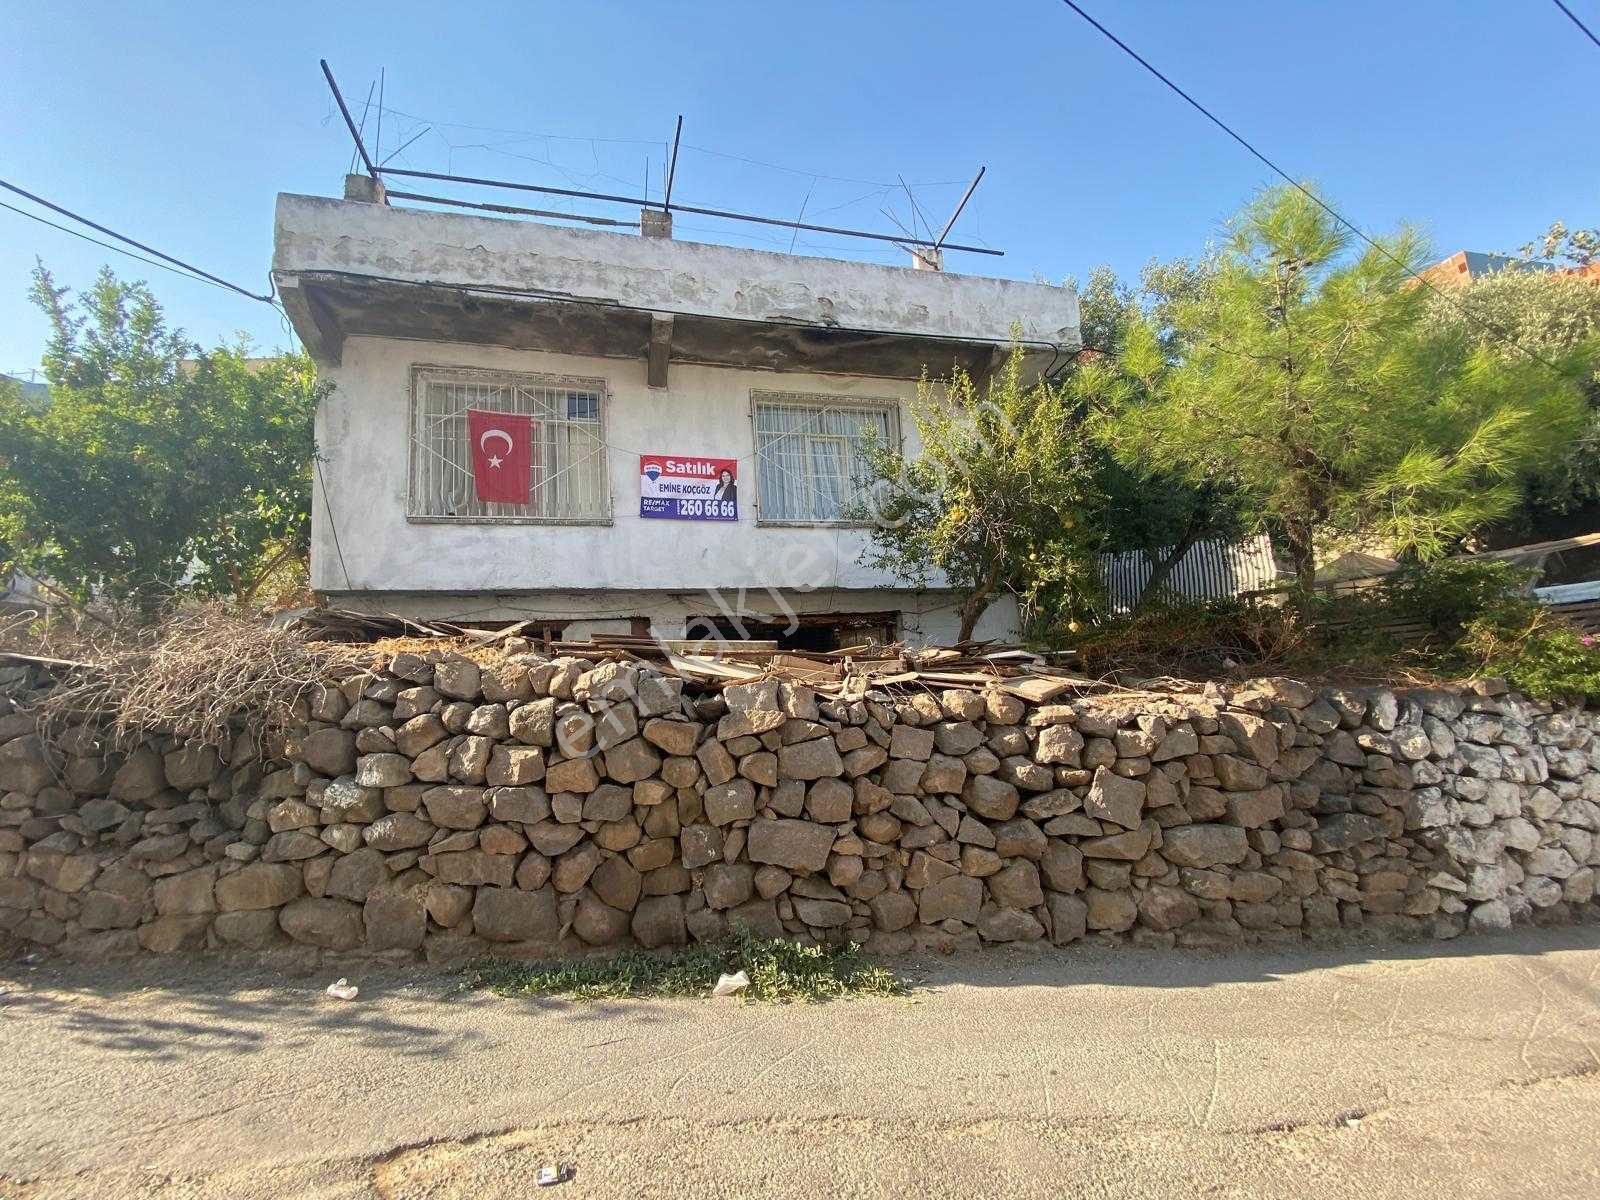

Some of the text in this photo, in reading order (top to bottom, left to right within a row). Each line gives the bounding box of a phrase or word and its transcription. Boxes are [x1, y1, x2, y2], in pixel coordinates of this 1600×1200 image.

[665, 460, 716, 476] Satılık
[659, 483, 682, 493] EMİNE
[681, 499, 703, 516] 260
[705, 500, 719, 517] 66
[721, 500, 735, 517] 66
